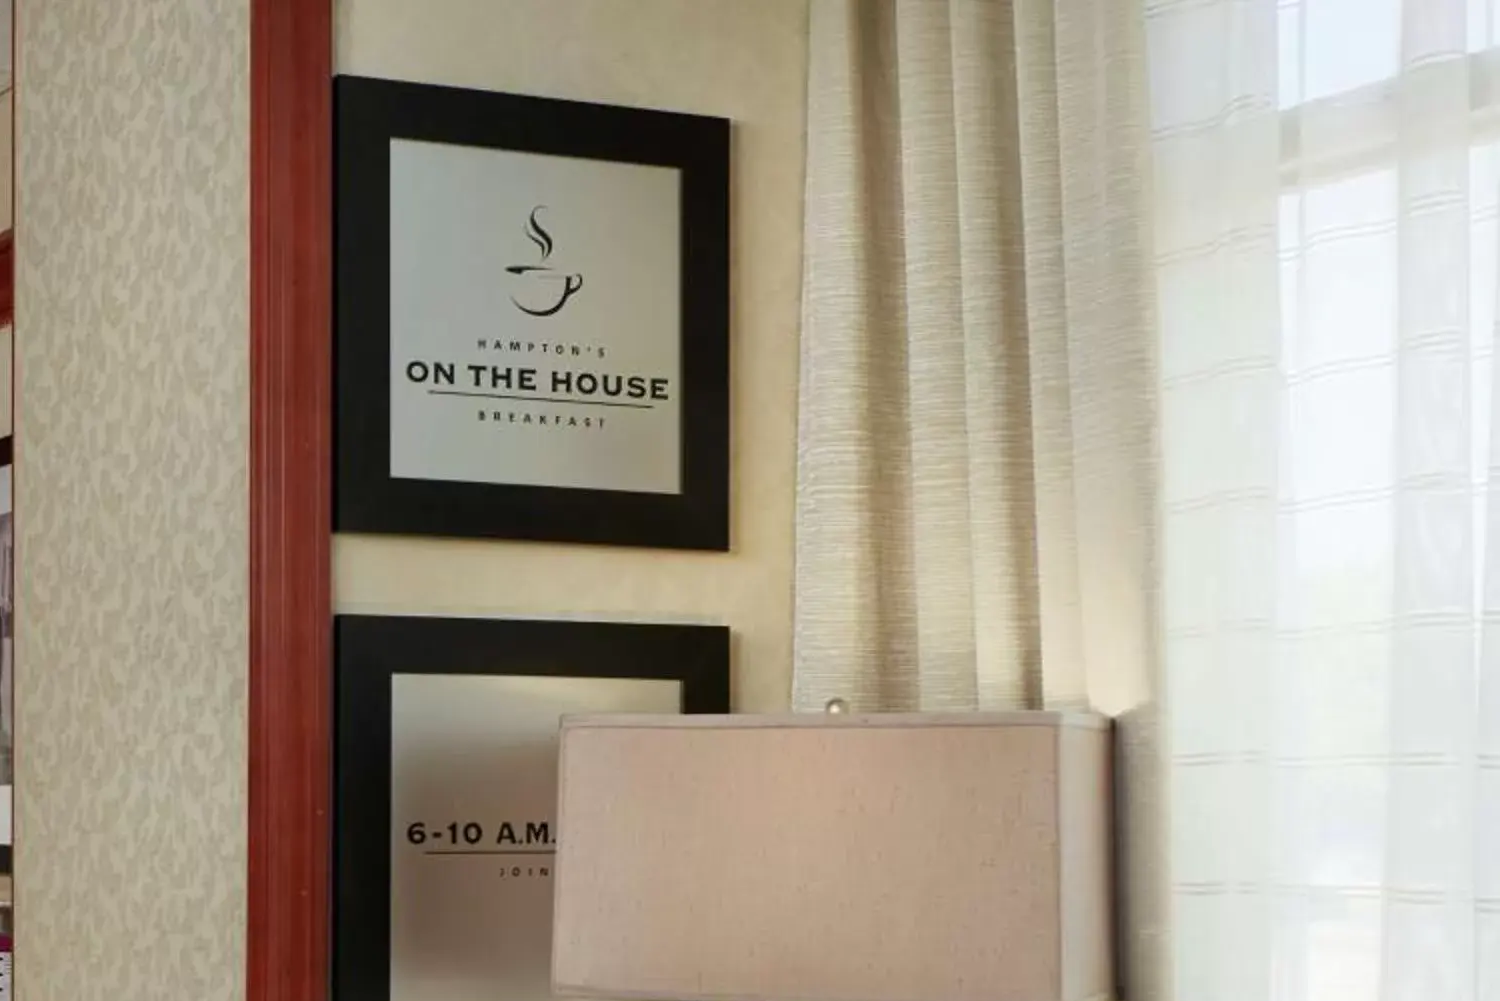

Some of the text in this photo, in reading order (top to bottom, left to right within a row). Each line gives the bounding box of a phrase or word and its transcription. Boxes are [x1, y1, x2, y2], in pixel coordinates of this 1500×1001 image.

[476, 338, 607, 358] HAMPTON'S
[405, 361, 670, 401] ON THE HOUSE
[477, 411, 607, 429] BREAKFAST
[406, 821, 483, 845] 6-10
